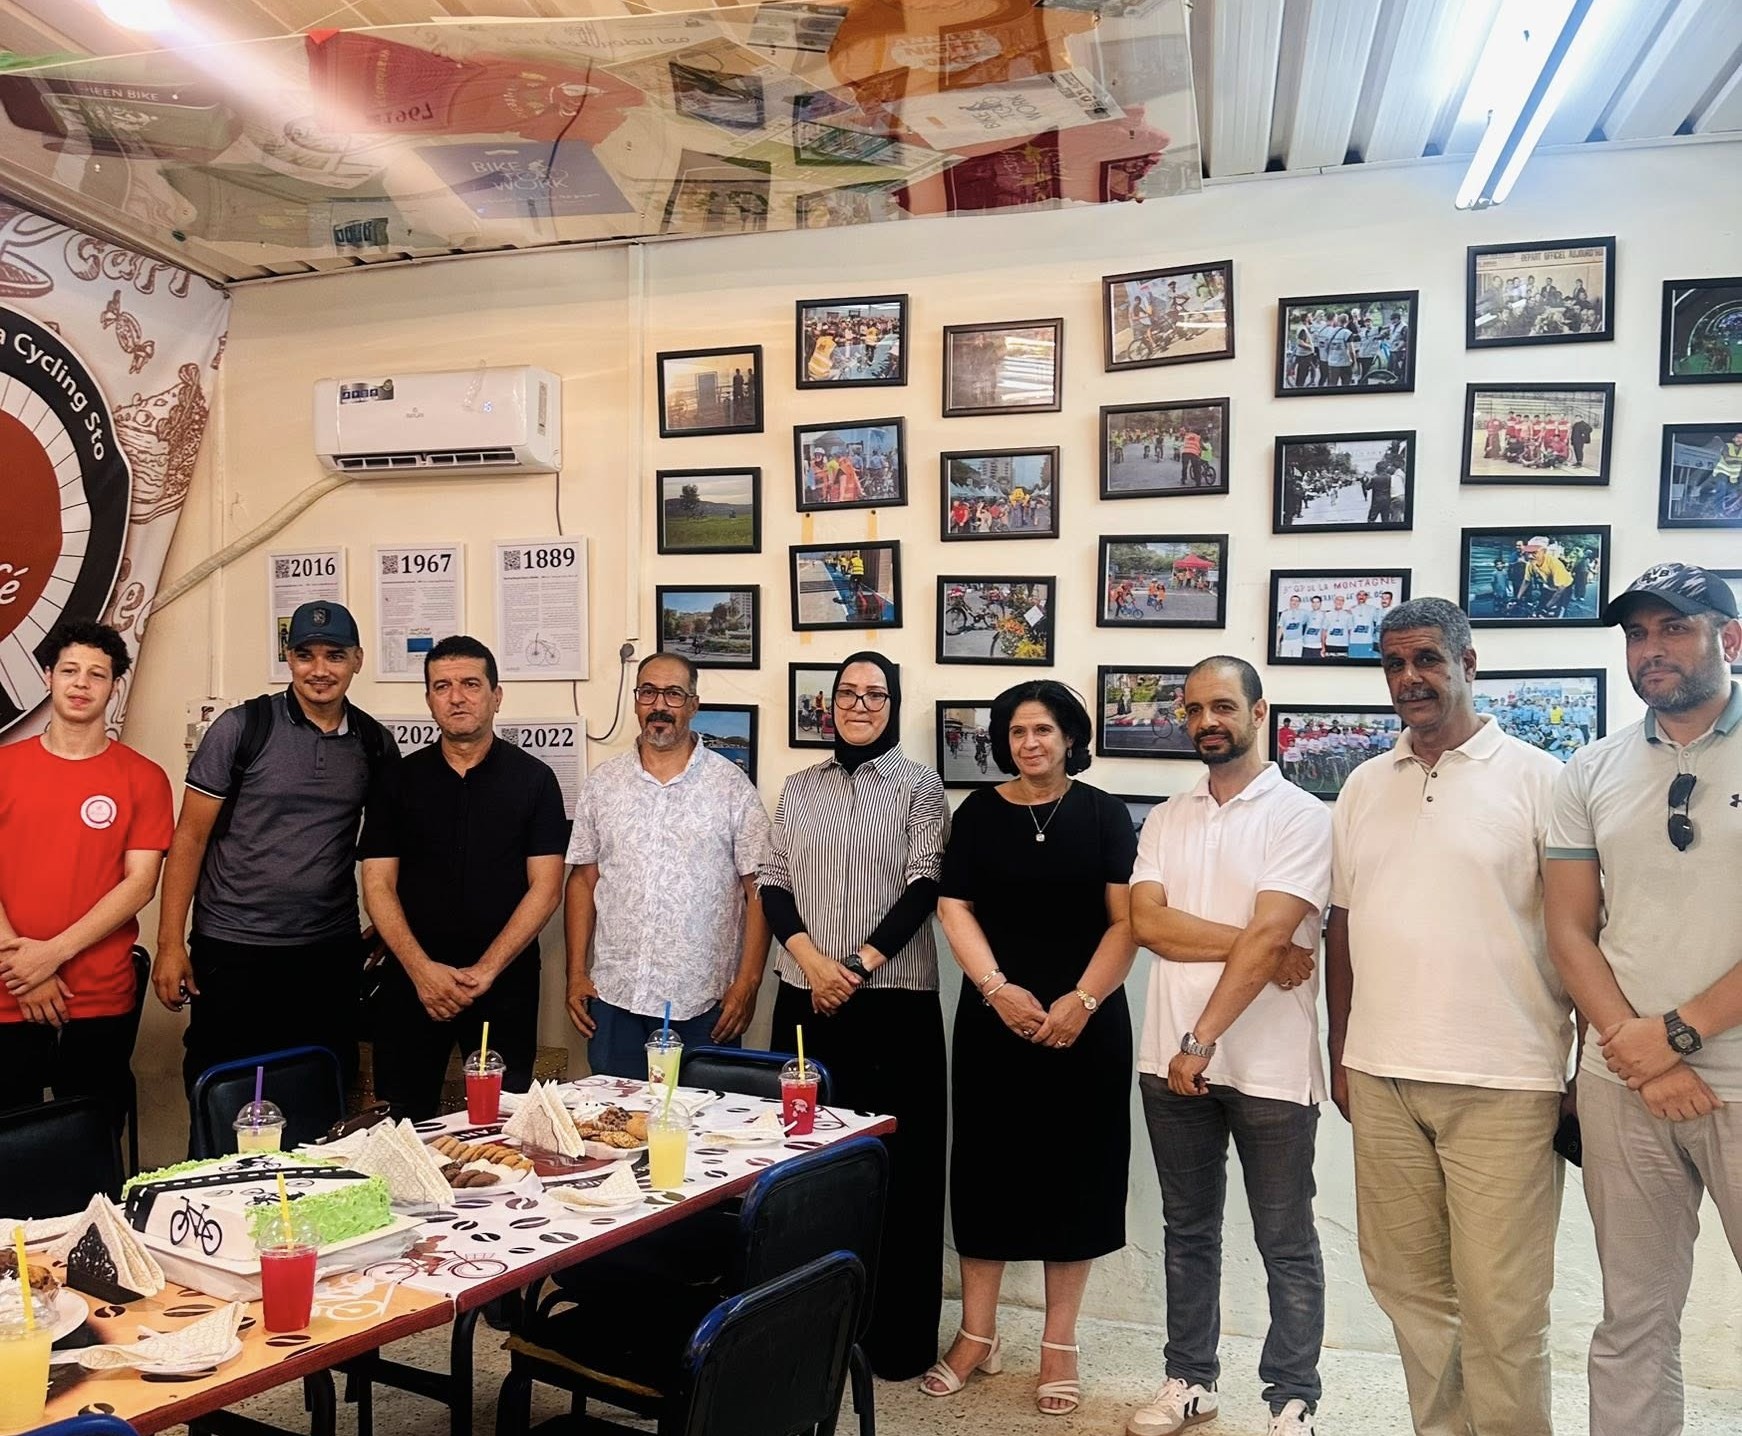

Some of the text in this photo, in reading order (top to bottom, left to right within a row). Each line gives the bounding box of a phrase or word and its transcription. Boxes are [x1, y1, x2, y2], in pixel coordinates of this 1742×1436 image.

[127, 89, 159, 101] BIKE
[472, 161, 522, 173] BIKE
[494, 179, 568, 191] WORK
[14, 333, 89, 413] Cycling
[290, 557, 336, 577] 2016
[401, 553, 452, 575] 1967
[523, 548, 576, 569] 1889
[1333, 577, 1398, 589] MONTAGNE
[397, 725, 442, 745] 202
[521, 728, 574, 748] 2022
